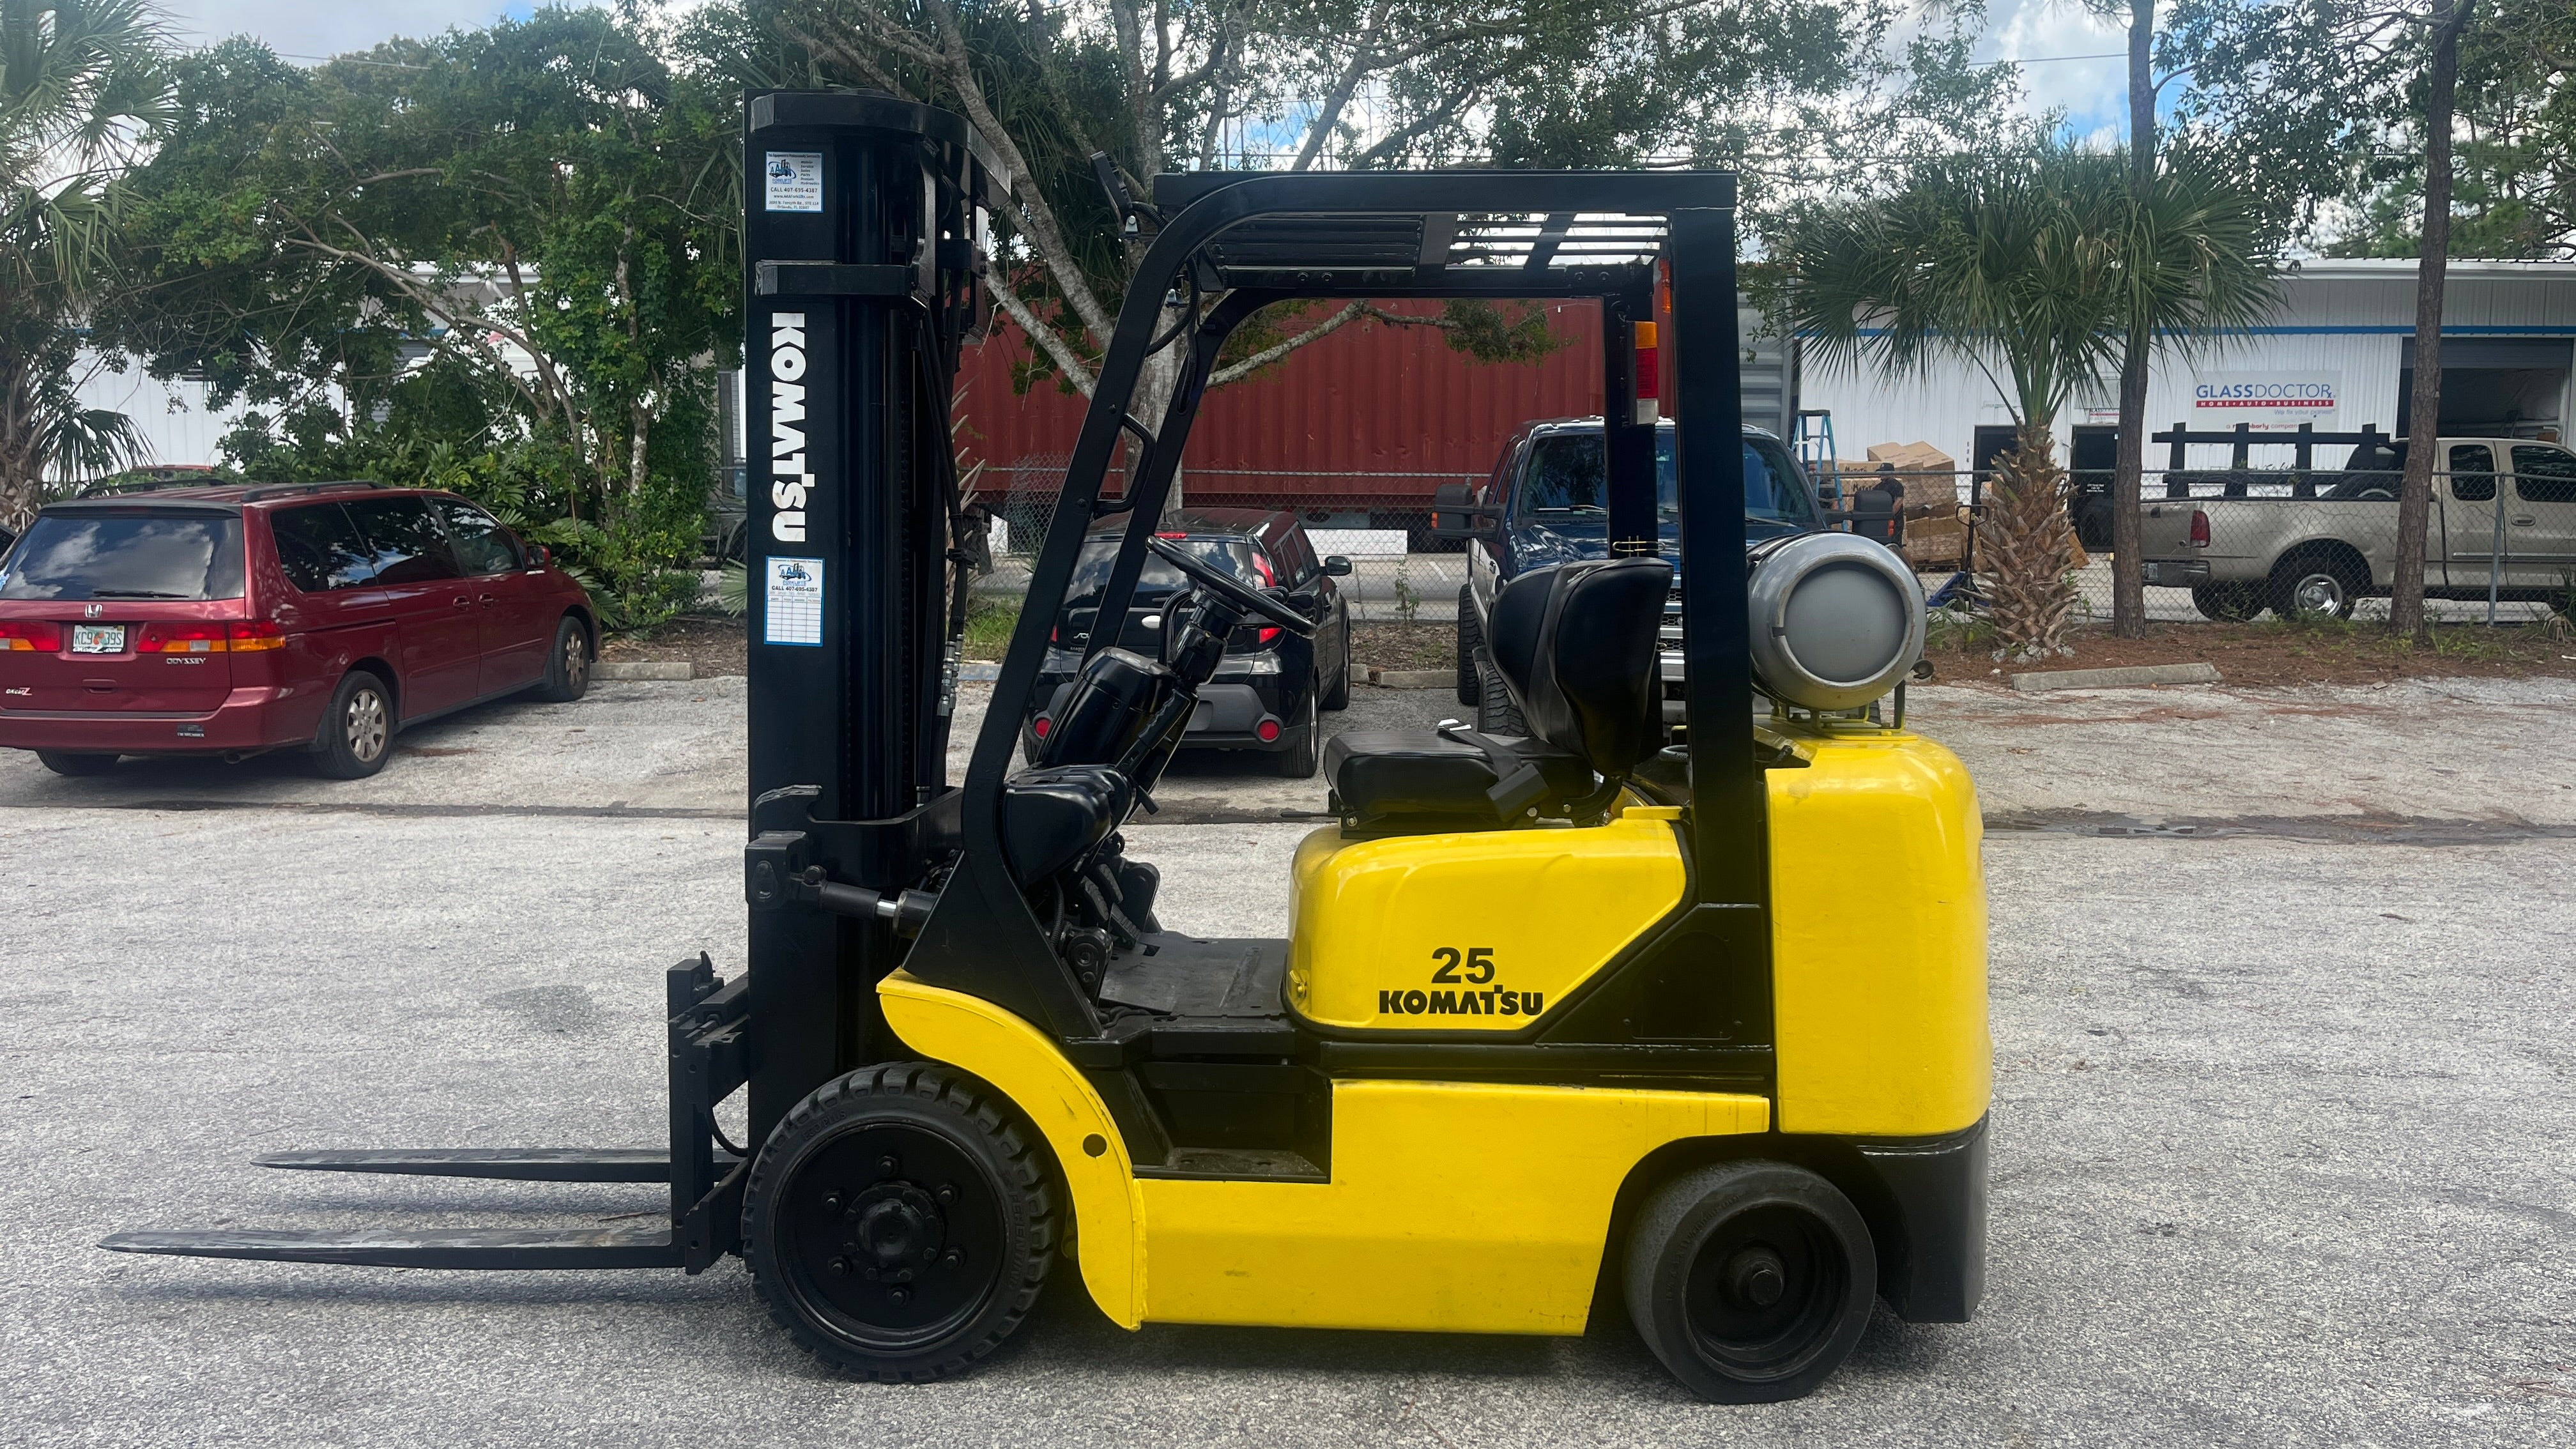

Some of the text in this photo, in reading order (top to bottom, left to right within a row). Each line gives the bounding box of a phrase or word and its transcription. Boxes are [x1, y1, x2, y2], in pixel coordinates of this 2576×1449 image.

[771, 312, 815, 542] KOMATSU
[1431, 947, 1495, 984] 25
[1379, 985, 1543, 1015] KOMATSU
